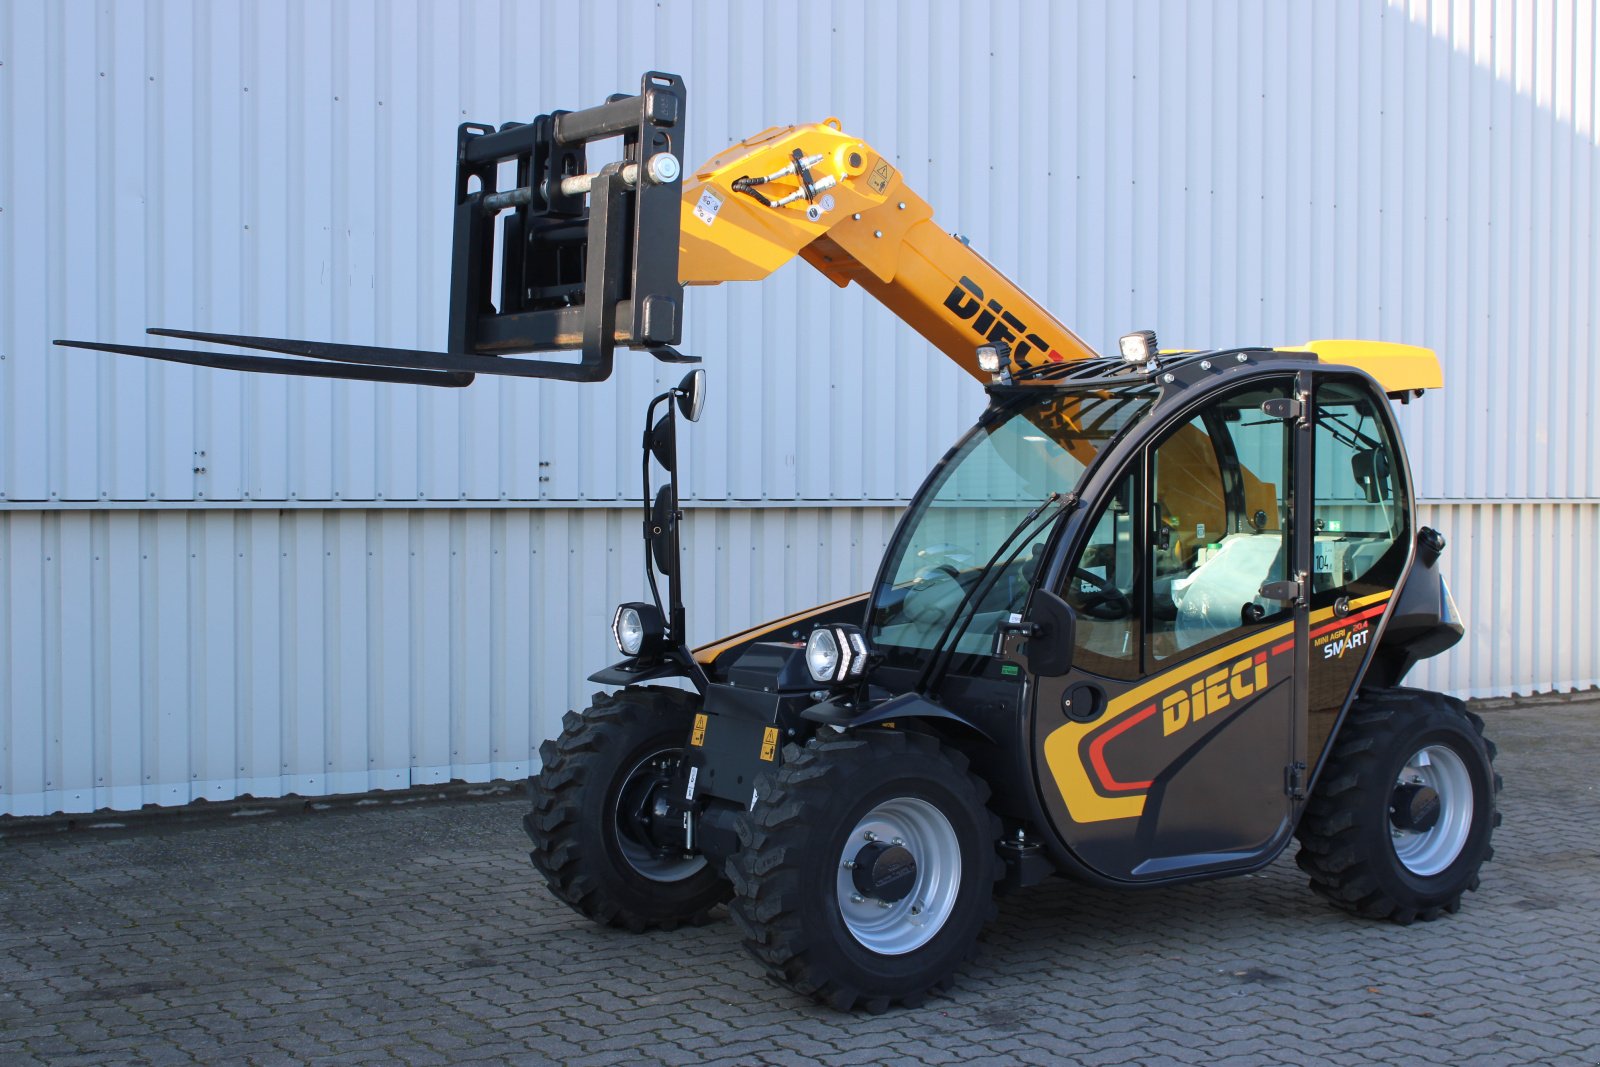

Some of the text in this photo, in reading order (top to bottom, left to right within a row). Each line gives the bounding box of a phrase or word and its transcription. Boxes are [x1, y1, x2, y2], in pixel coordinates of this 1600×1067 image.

[1353, 621, 1368, 632] 20.4
[1314, 629, 1346, 647] MINI AGRI
[1324, 630, 1368, 658] SMART
